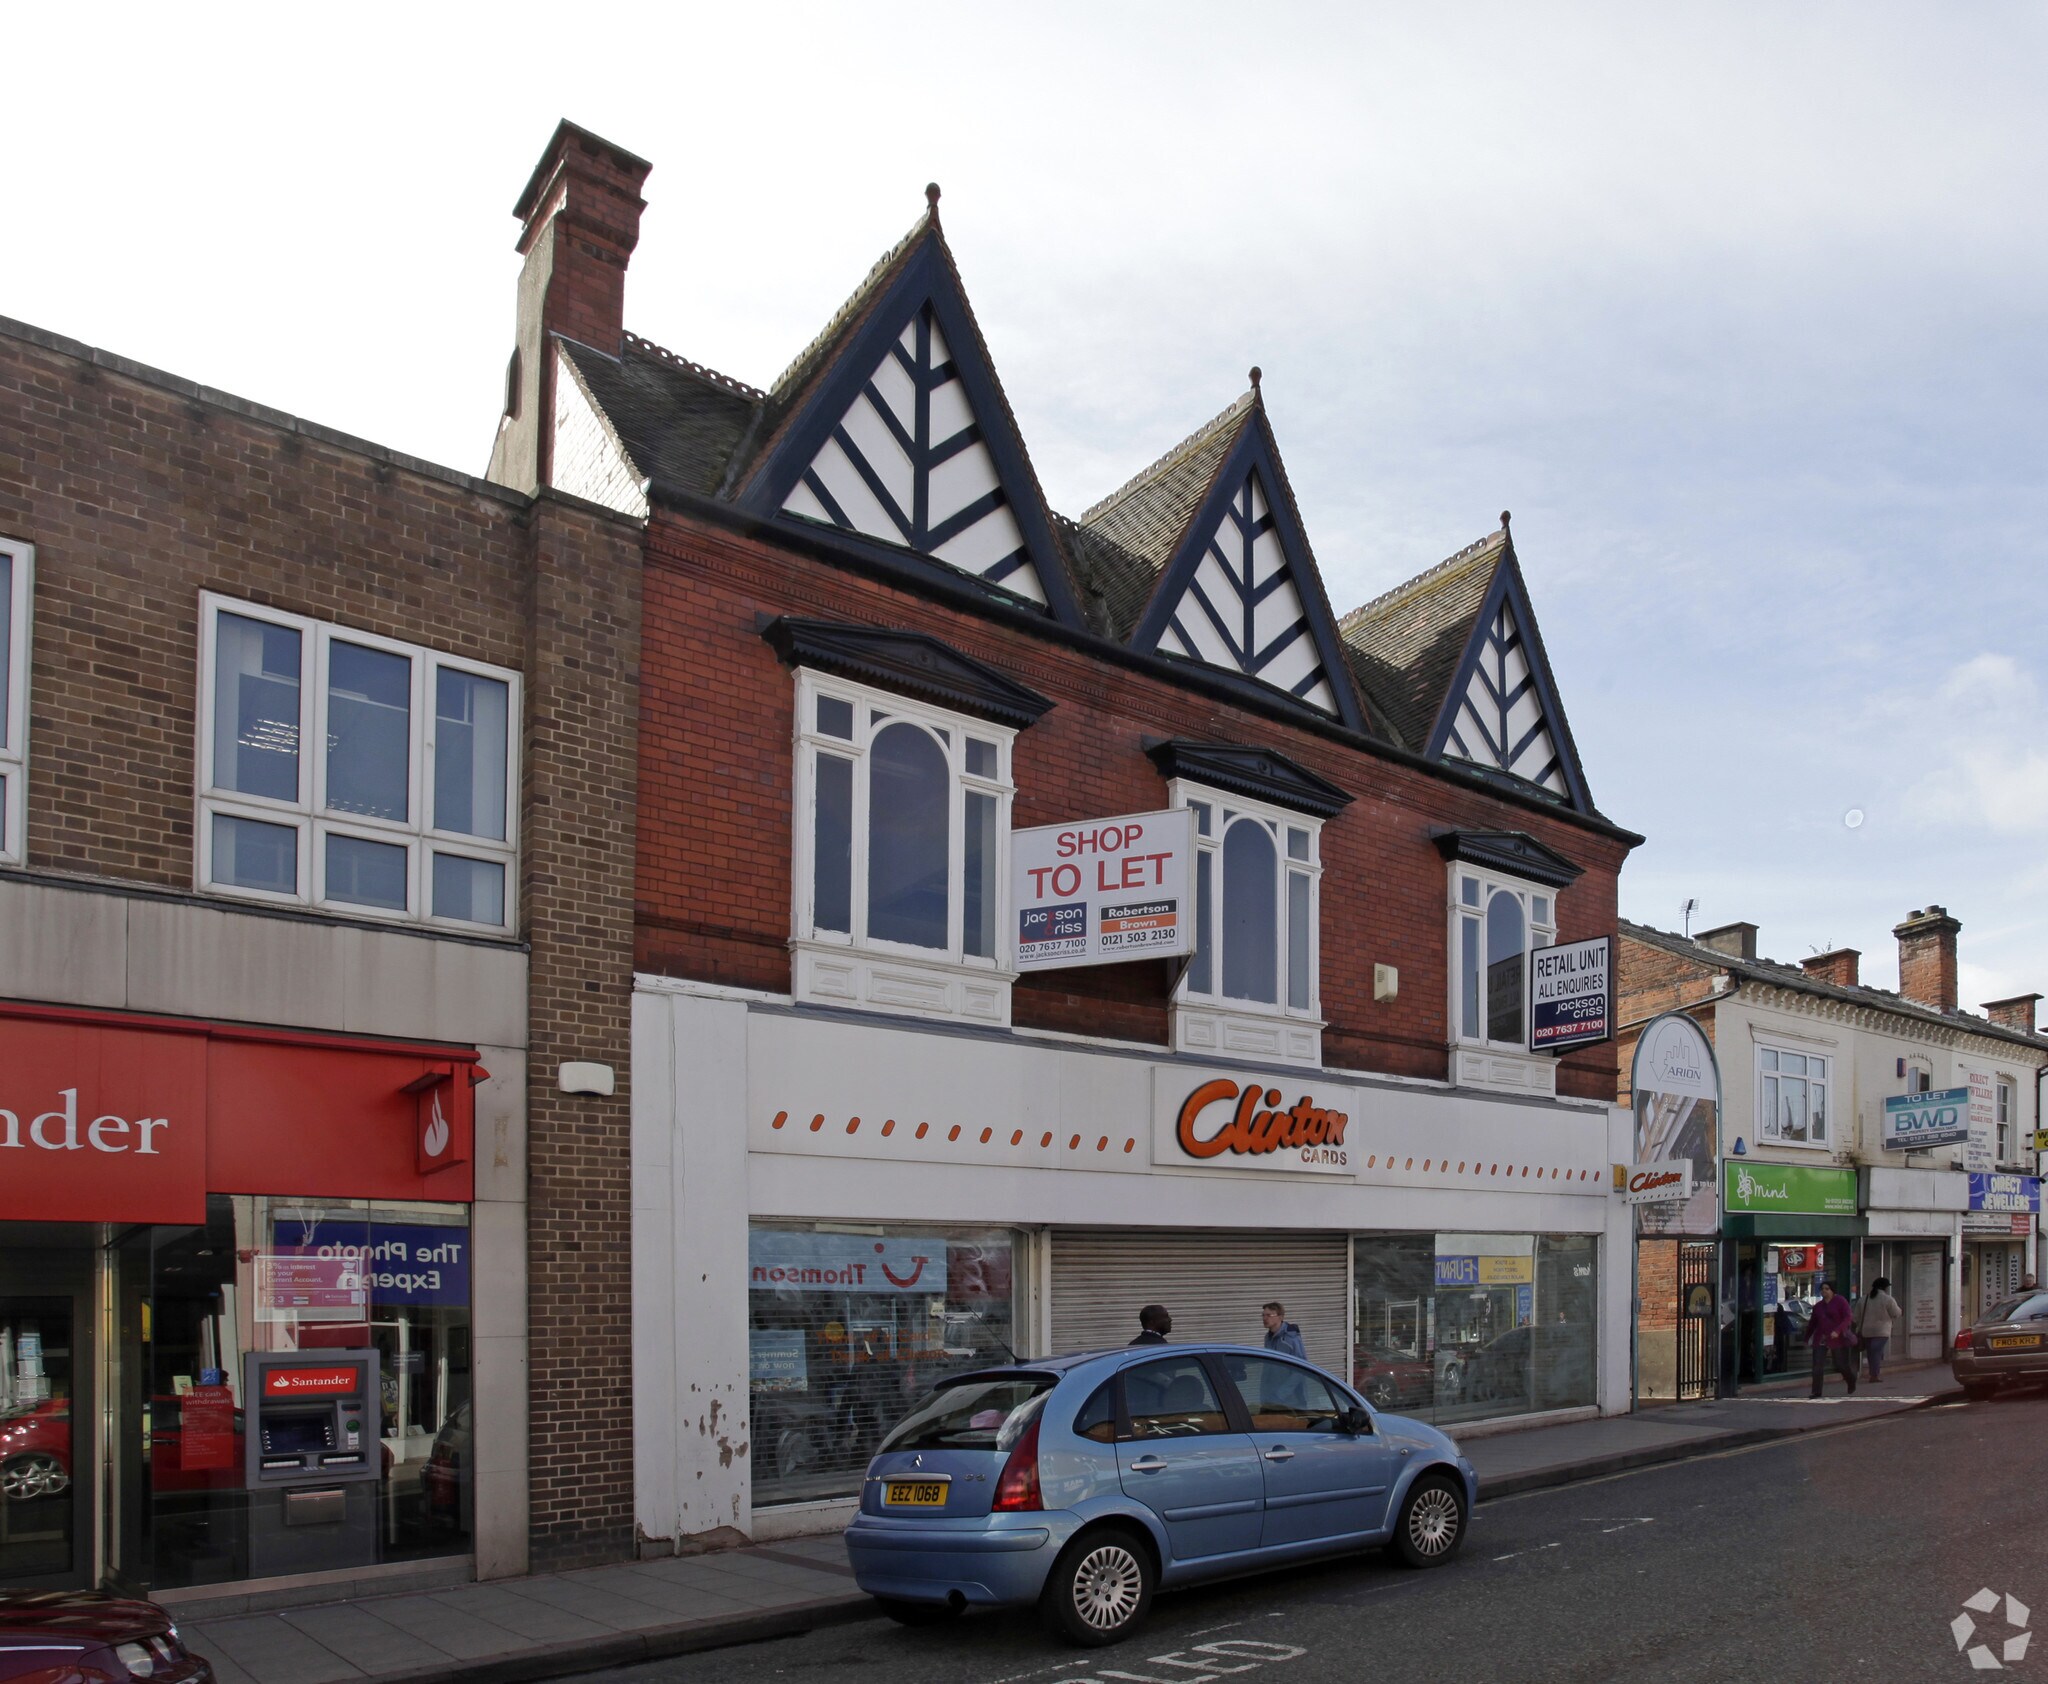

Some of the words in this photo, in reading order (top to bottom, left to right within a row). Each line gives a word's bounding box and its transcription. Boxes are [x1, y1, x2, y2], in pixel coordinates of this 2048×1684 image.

[1056, 824, 1143, 857] SHOP
[1027, 863, 1081, 899] TO
[1097, 852, 1173, 892] LET
[1108, 905, 1169, 918] Robertson
[1120, 920, 1157, 930] Brown
[1020, 944, 1036, 953] 020
[1039, 941, 1061, 951] 7637
[1065, 938, 1087, 949] 7100
[1101, 935, 1122, 945] 0121
[1127, 932, 1147, 943] 503
[1151, 928, 1176, 940] 2130
[1537, 952, 1576, 979] RETAIL
[1579, 946, 1606, 971] UNIT
[1538, 982, 1555, 999] ALL
[1557, 973, 1604, 996] ENQUIRIES
[1556, 996, 1604, 1015] jackson
[1573, 1006, 1603, 1019] criss
[1536, 1027, 1554, 1038] 020
[1556, 1024, 1578, 1035] 7637
[1580, 1020, 1603, 1031] 7100
[1667, 1066, 1701, 1080] ARION
[1904, 1094, 1922, 1103] TO
[1925, 1091, 1949, 1100] LET
[1176, 1078, 1349, 1159] Clinton
[1895, 1107, 1958, 1132] BWD
[1300, 1147, 1348, 1166] CARDS
[1629, 1171, 1682, 1193] Clinton
[1990, 1175, 2022, 1195] DIRECT
[1981, 1193, 2030, 1211] JEWELLERS
[291, 1376, 351, 1387] Santander
[891, 1485, 912, 1502] EEZ
[913, 1485, 940, 1502] 1068
